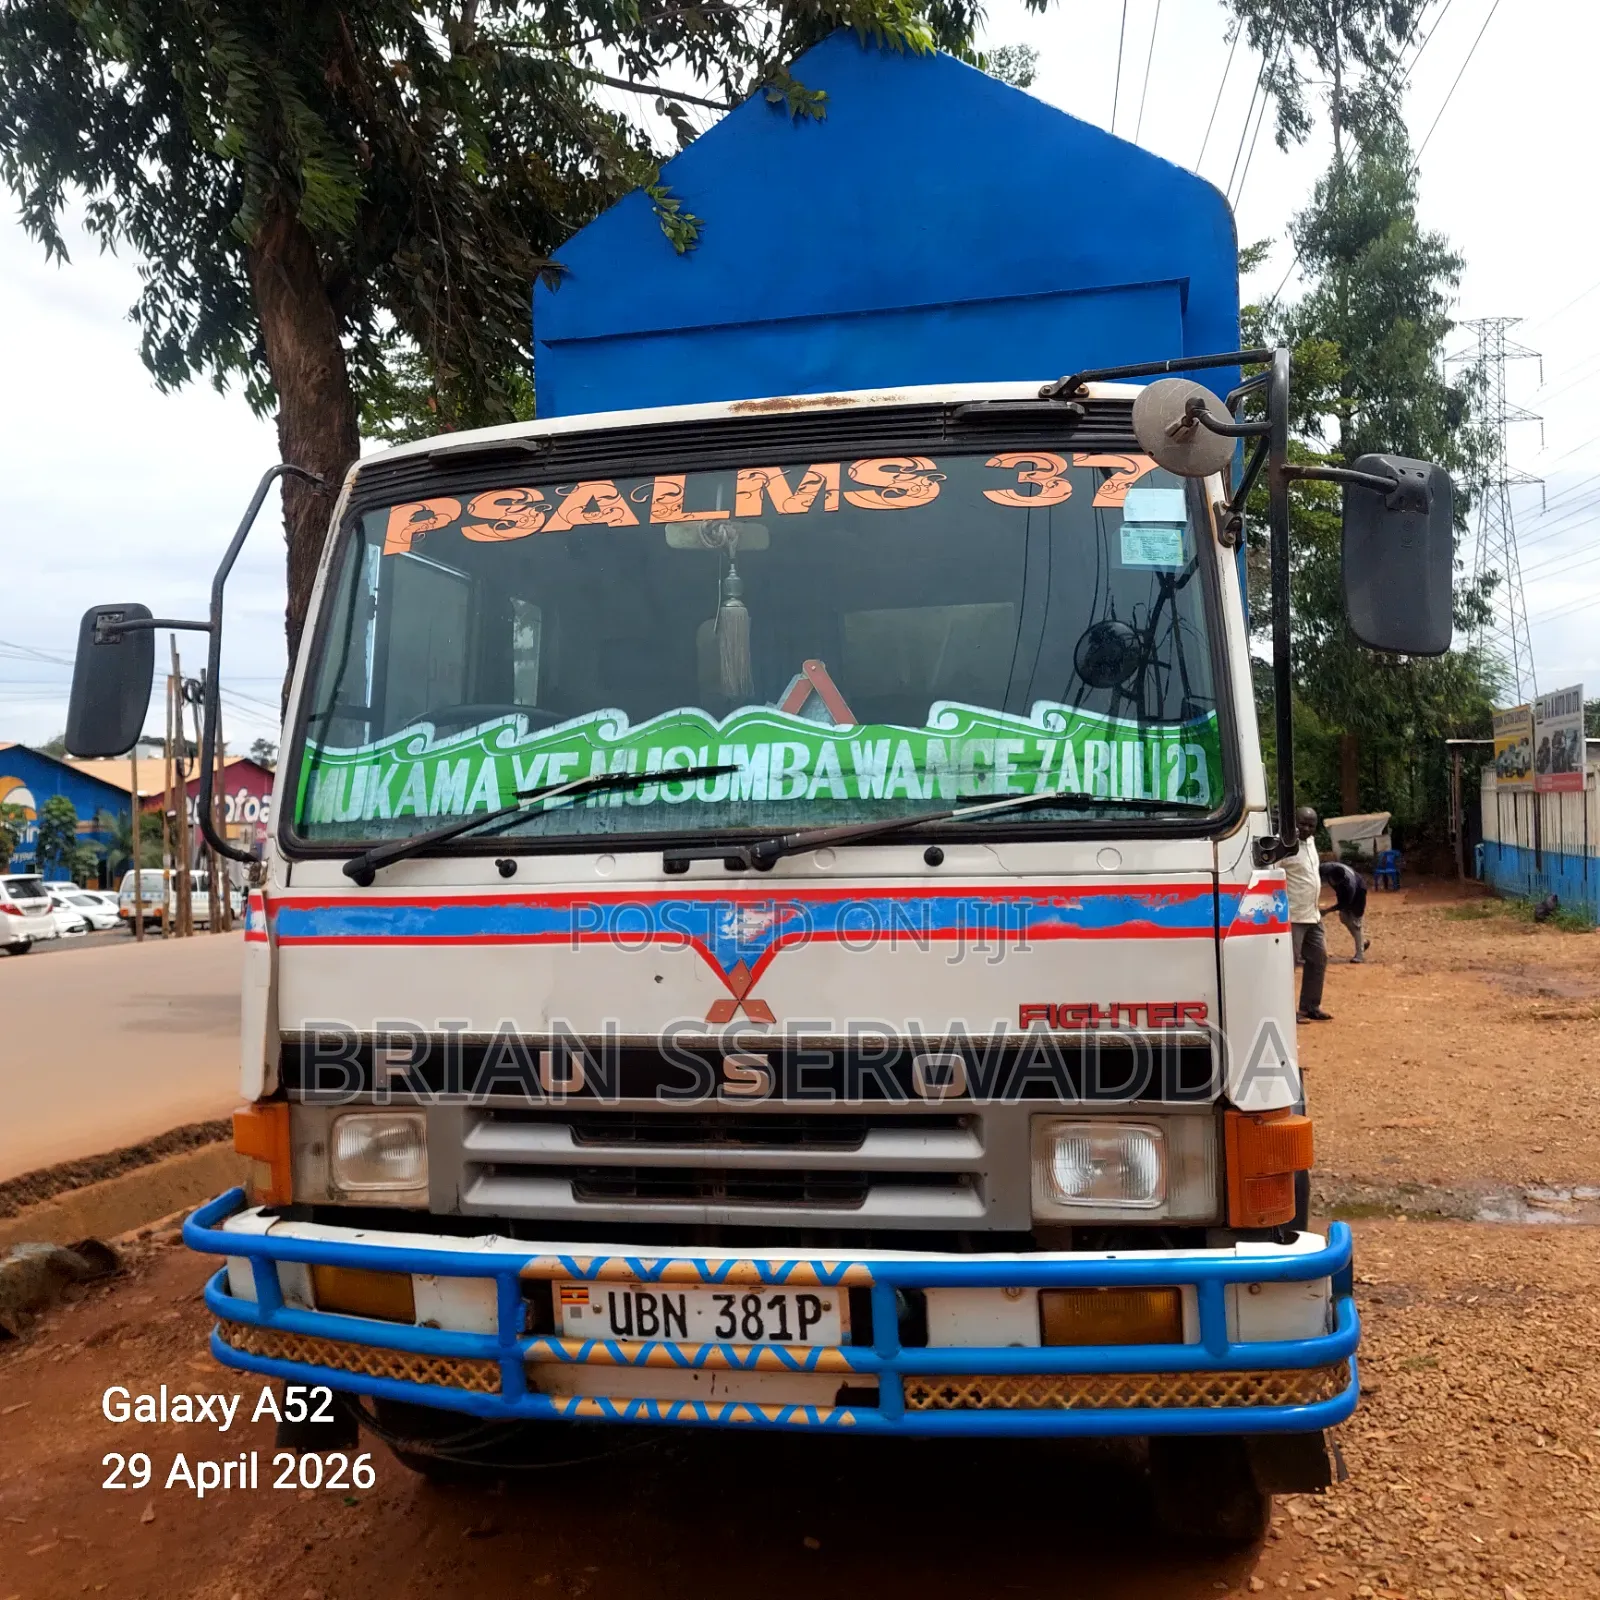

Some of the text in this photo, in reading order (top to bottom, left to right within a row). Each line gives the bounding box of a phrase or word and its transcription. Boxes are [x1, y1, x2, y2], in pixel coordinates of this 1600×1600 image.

[383, 451, 1161, 556] PSALMS 37
[306, 756, 501, 824] MUKAMA
[512, 751, 579, 812] YE
[585, 740, 849, 809] MUSUMBA
[1166, 743, 1211, 807] 23
[1019, 1001, 1209, 1030] FIGHTER
[607, 1291, 823, 1341] UBN 381P
